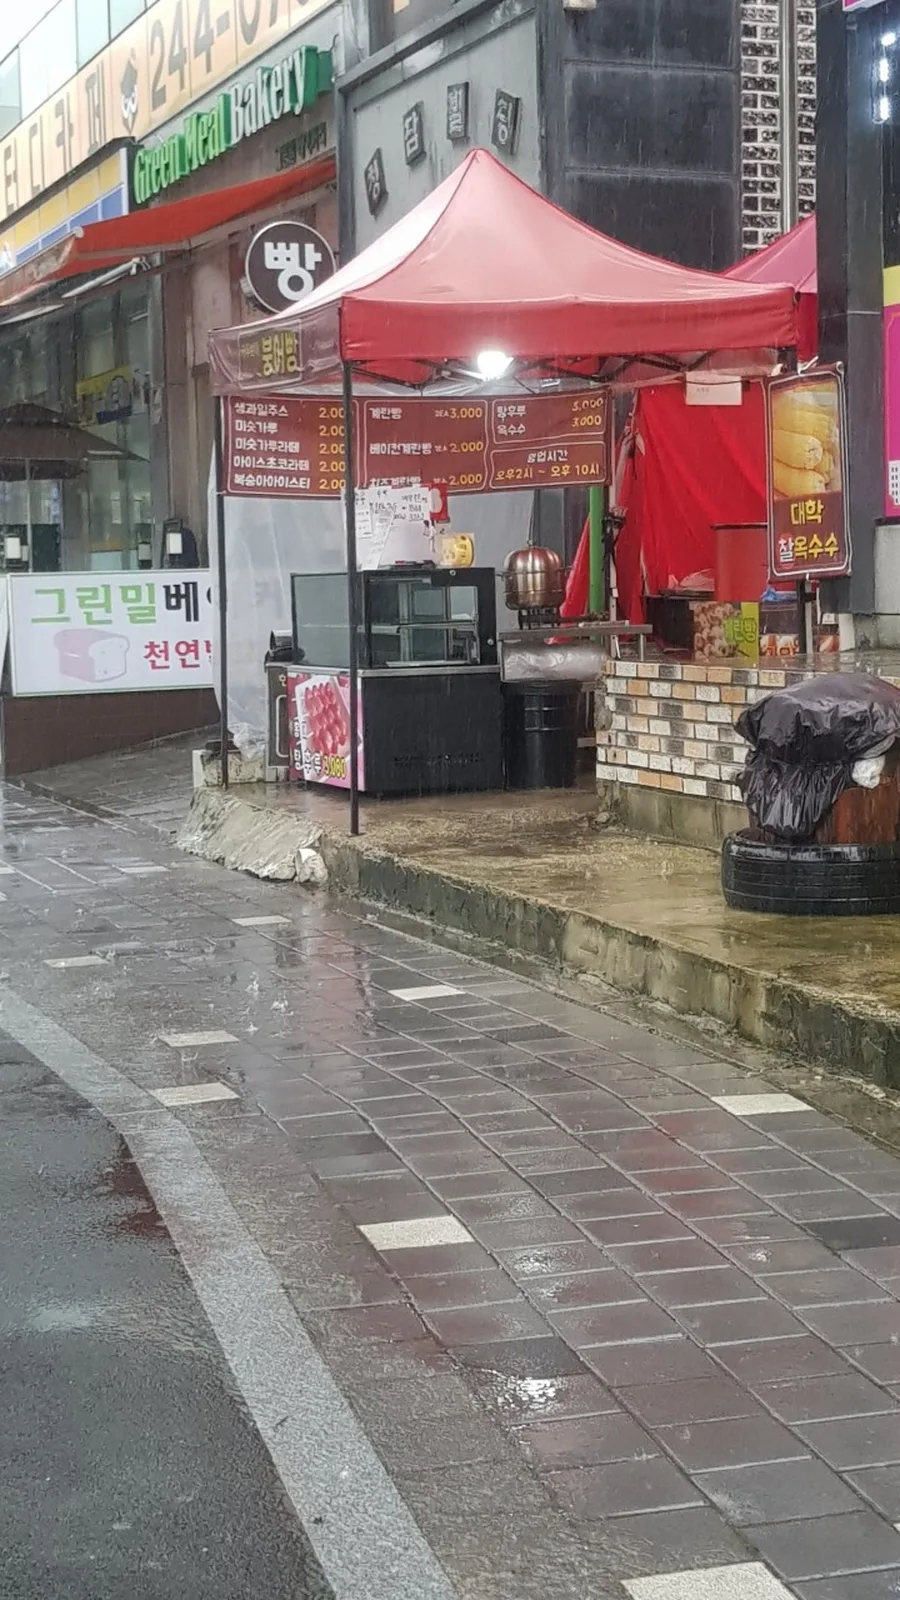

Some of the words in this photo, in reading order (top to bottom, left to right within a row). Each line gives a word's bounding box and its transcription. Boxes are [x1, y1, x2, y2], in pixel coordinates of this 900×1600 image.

[133, 134, 182, 204] Green
[184, 93, 227, 171] Meal
[230, 46, 307, 148] Bakery
[264, 241, 322, 301] 빵
[235, 402, 289, 417] 생과일주스
[369, 407, 402, 419] 계란빵
[497, 405, 526, 419] 탕후루
[235, 419, 278, 434] 미숫가루
[497, 424, 526, 435] 옥수수
[527, 449, 568, 463] 영업시간
[495, 467, 533, 480] 오후2시
[551, 464, 571, 477] 오후
[575, 463, 600, 476] 10시
[234, 474, 310, 489] 복숭아아이스티
[790, 499, 824, 525] 대학
[778, 532, 839, 563] 찰옥수수
